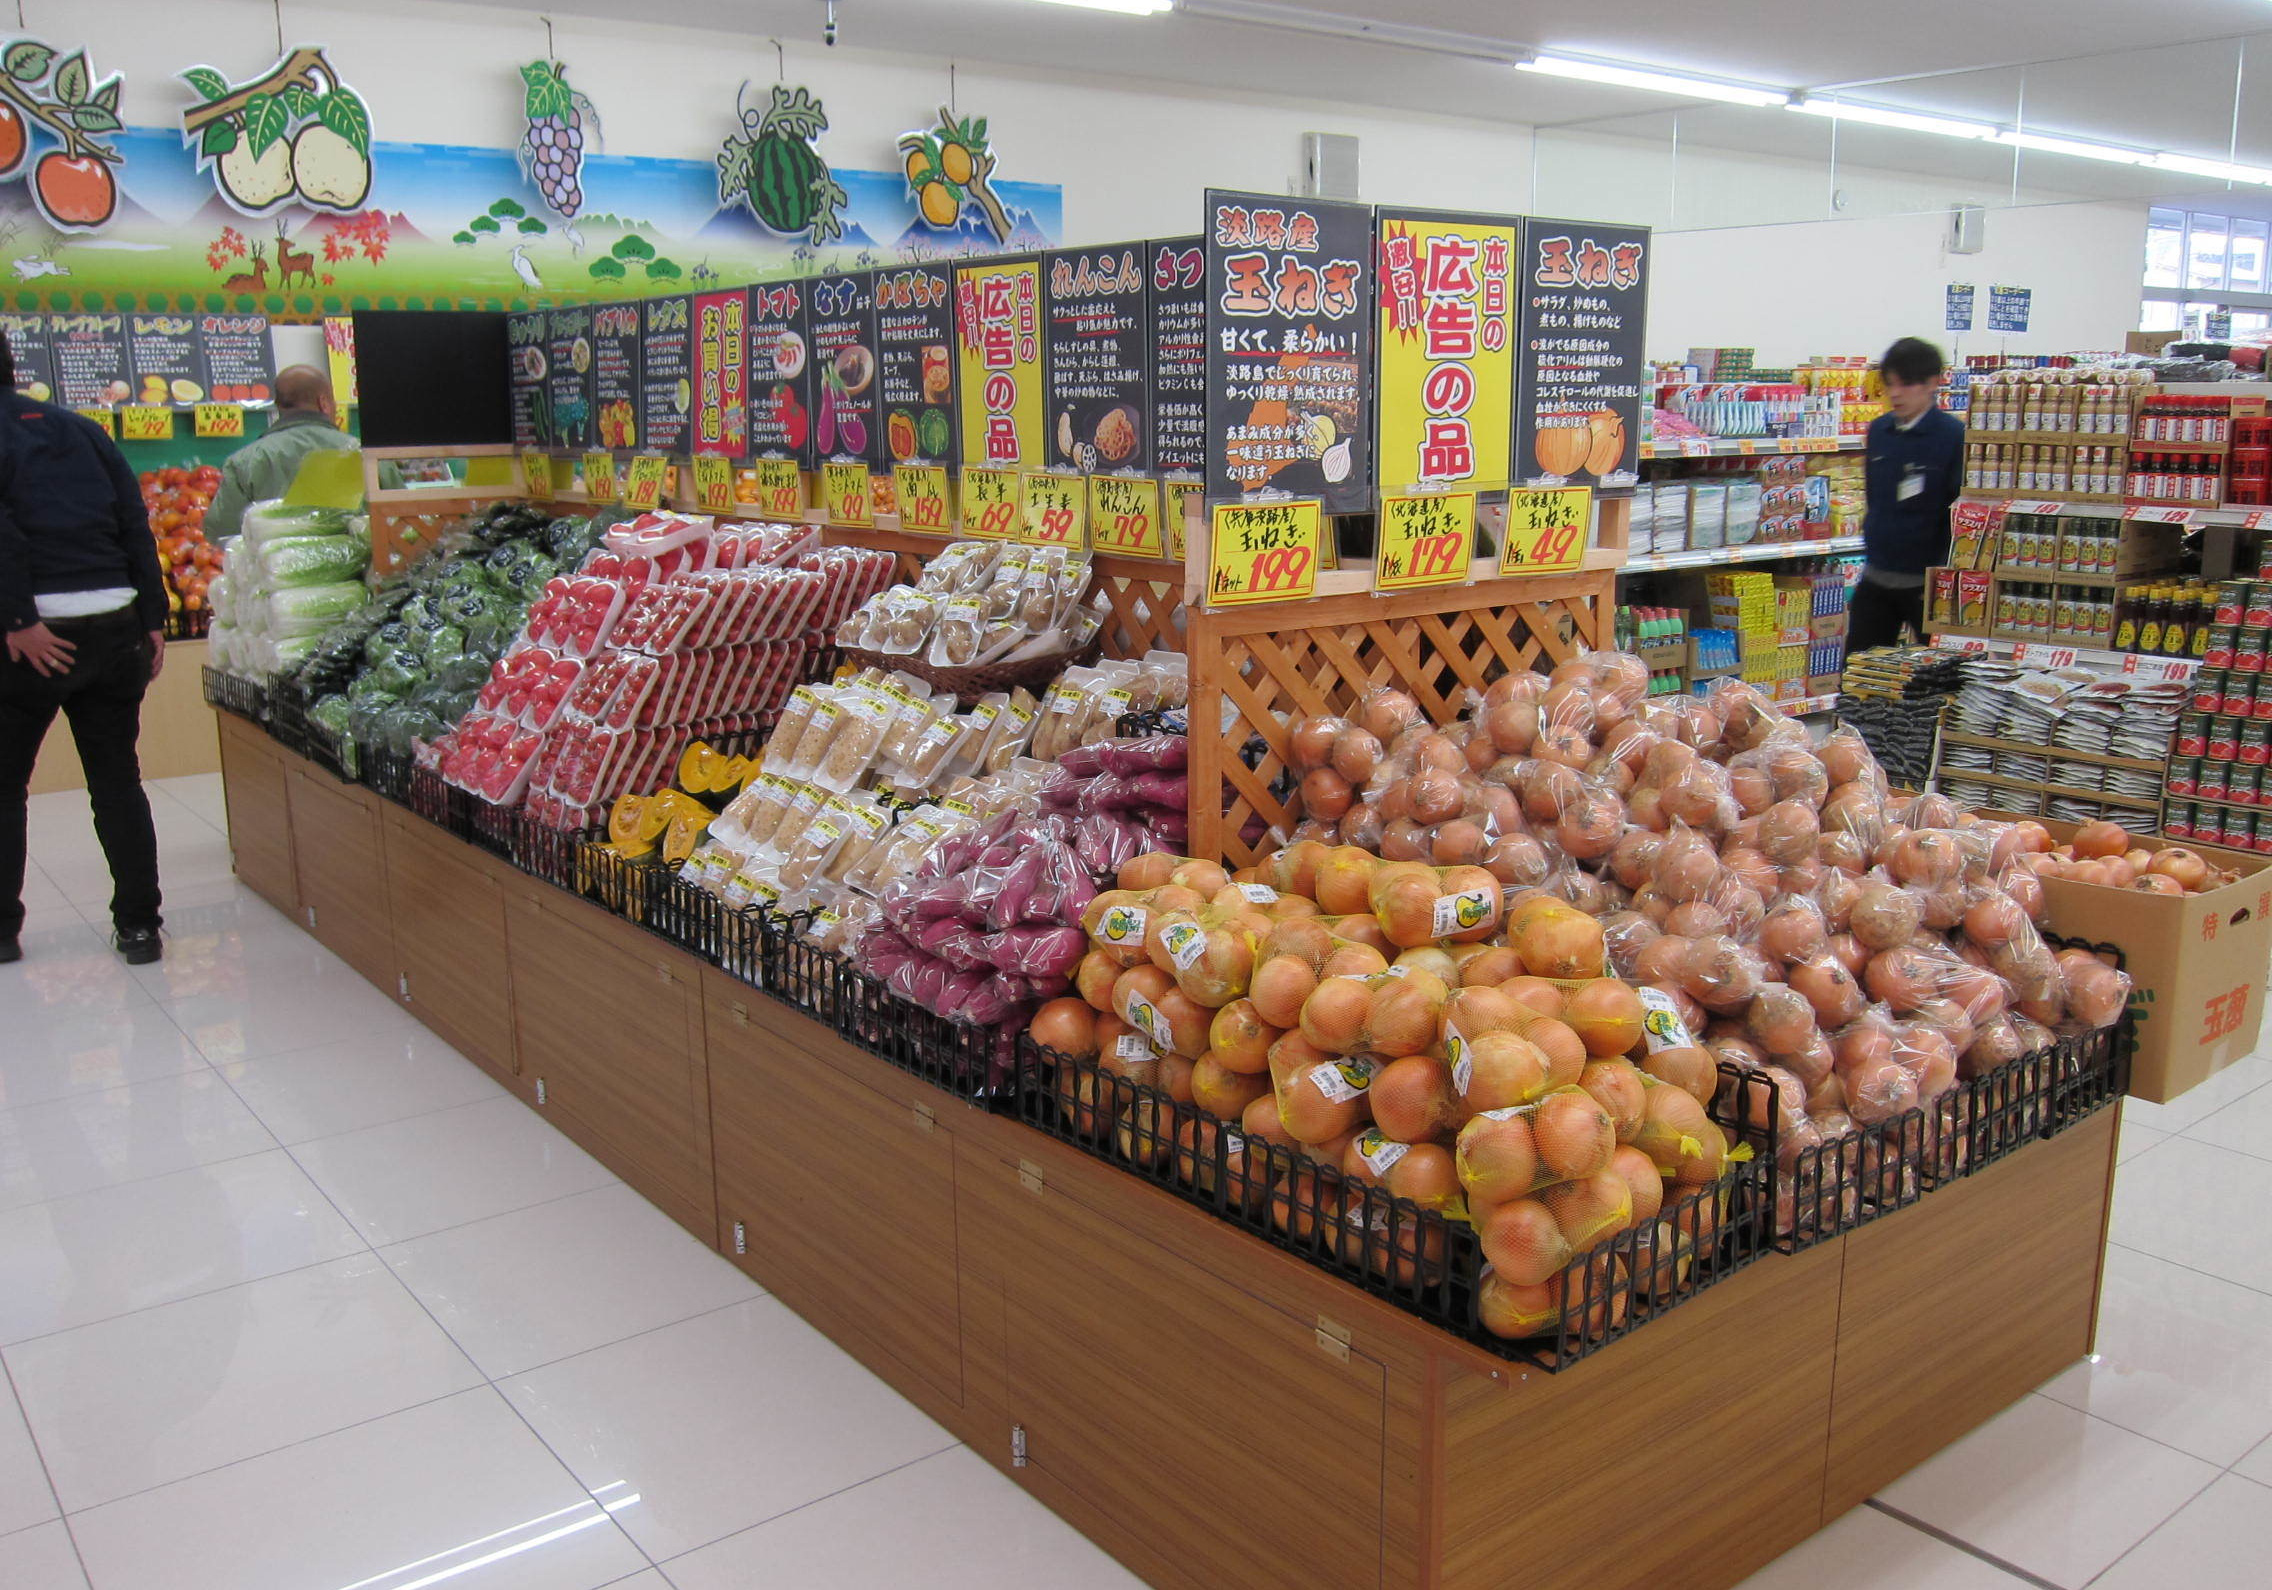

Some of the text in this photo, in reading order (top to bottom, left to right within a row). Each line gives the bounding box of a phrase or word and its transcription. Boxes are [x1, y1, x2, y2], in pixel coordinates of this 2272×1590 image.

[1215, 206, 1319, 253] 淡路産
[1051, 251, 1142, 300] れんこん
[1535, 236, 1643, 290] 玉ねぎ
[757, 283, 800, 322] トマト
[876, 269, 947, 309] かぼちゃ
[1220, 251, 1361, 320] 玉ねぎ
[1481, 236, 1508, 352] 本日の
[1016, 271, 1037, 363] 本日の
[723, 298, 743, 393] 本日の
[1418, 234, 1479, 483] 広告の品
[700, 305, 721, 443] お買い得
[981, 273, 1021, 463] 広告の品
[842, 494, 864, 520] 99
[915, 497, 944, 527] 159
[981, 502, 1016, 532] 69
[1039, 509, 1074, 542] 59
[1403, 512, 1461, 540] 玉ねぎ
[1528, 506, 1579, 530] 玉ねぎ
[1114, 514, 1149, 547] 79
[1240, 524, 1306, 552] 玉ねぎ
[1530, 525, 1578, 564] 49
[1247, 546, 1311, 593] 199
[1408, 532, 1463, 577] 179
[2050, 650, 2074, 667] 179
[2162, 662, 2188, 680] 199
